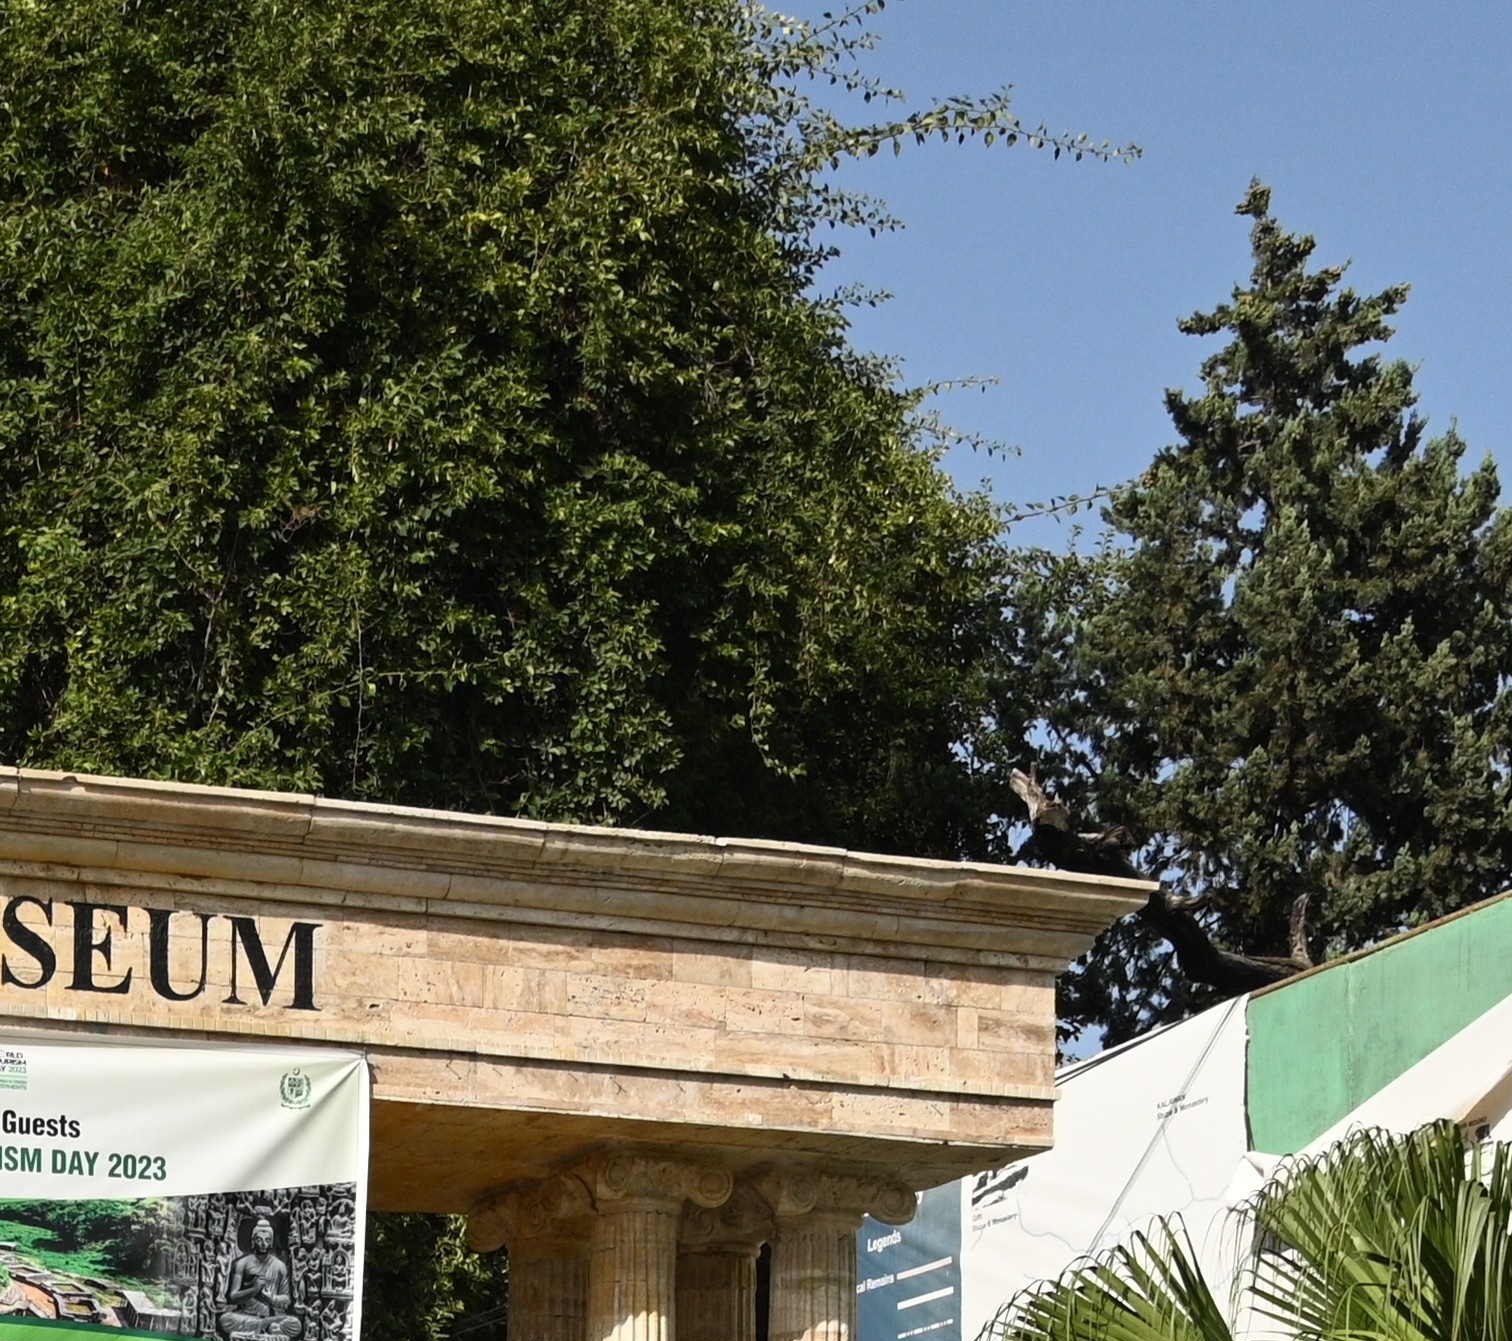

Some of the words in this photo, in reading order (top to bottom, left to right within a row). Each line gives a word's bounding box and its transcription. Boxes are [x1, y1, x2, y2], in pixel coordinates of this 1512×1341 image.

[2, 1110, 81, 1138] Guests
[51, 1150, 99, 1176] DAY
[107, 1153, 167, 1181] 2023
[867, 1229, 901, 1253] Legends
